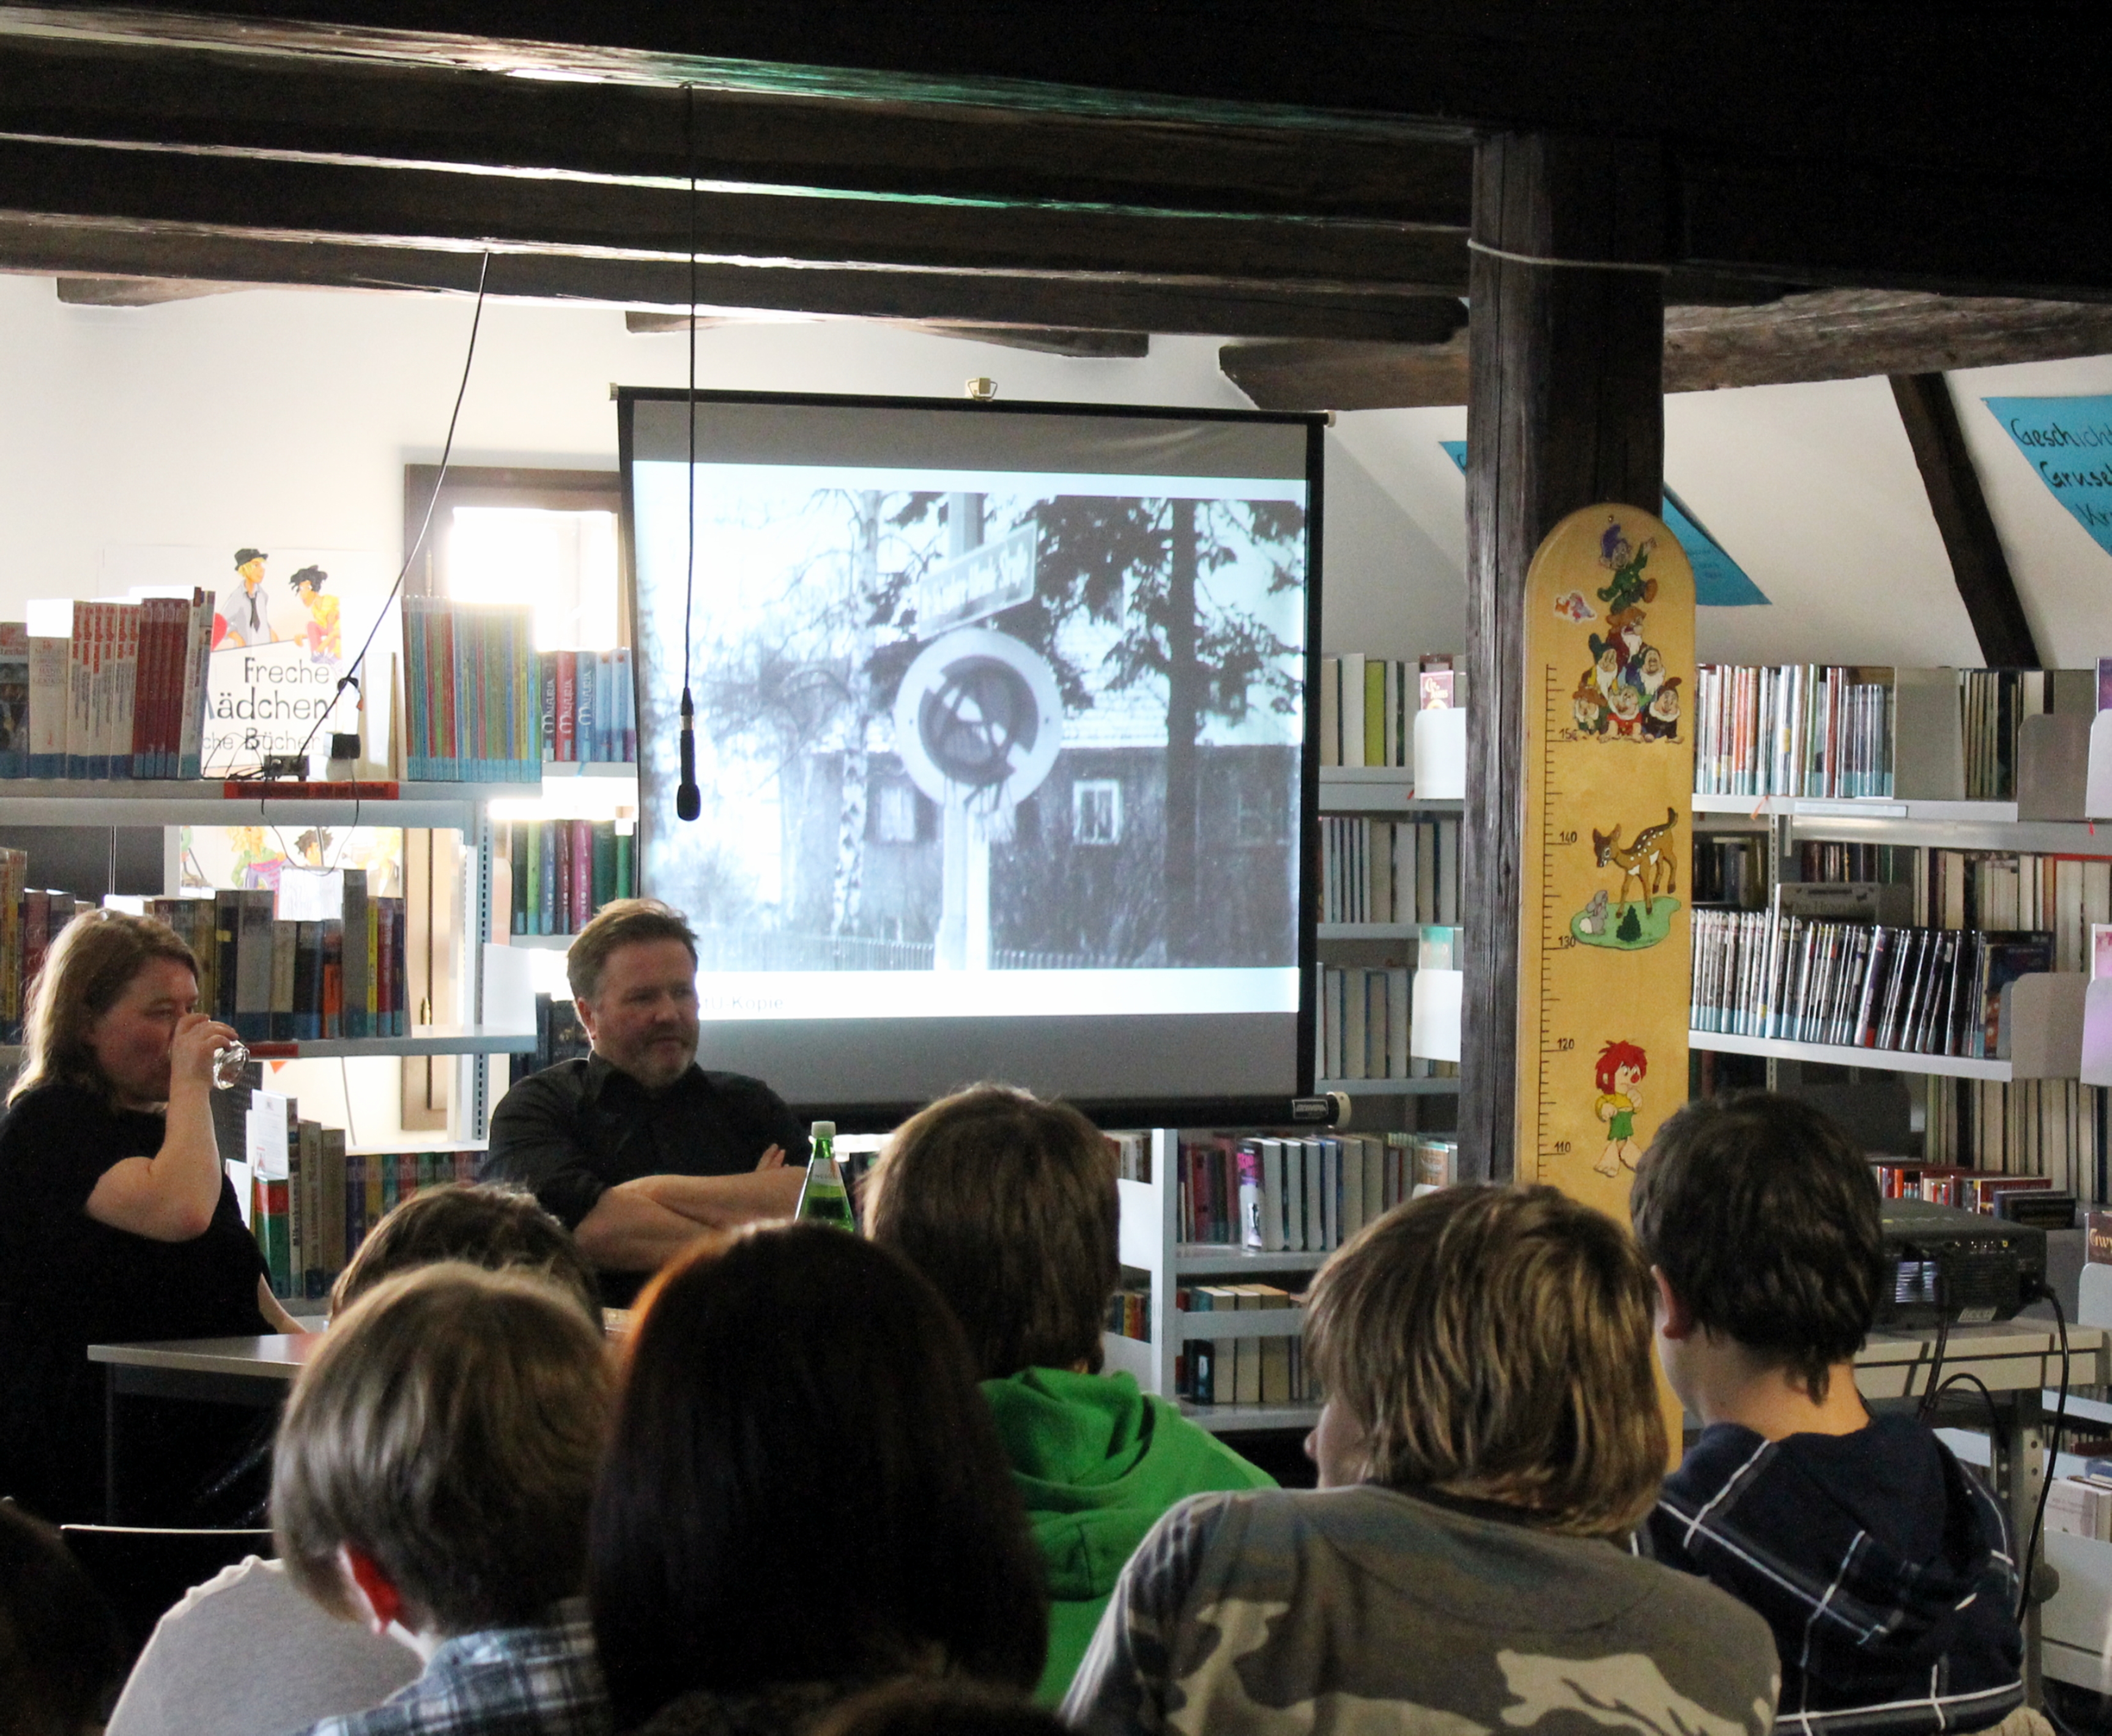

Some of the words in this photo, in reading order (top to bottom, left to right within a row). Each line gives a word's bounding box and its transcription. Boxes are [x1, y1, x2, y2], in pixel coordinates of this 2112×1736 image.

[245, 656, 329, 684] Freche
[558, 679, 573, 734] MALFURIA
[245, 727, 321, 751] Bücher
[1559, 831, 1577, 844] 140
[1558, 936, 1576, 948] 130
[1557, 1037, 1575, 1050] 120
[1554, 1141, 1571, 1153] 110
